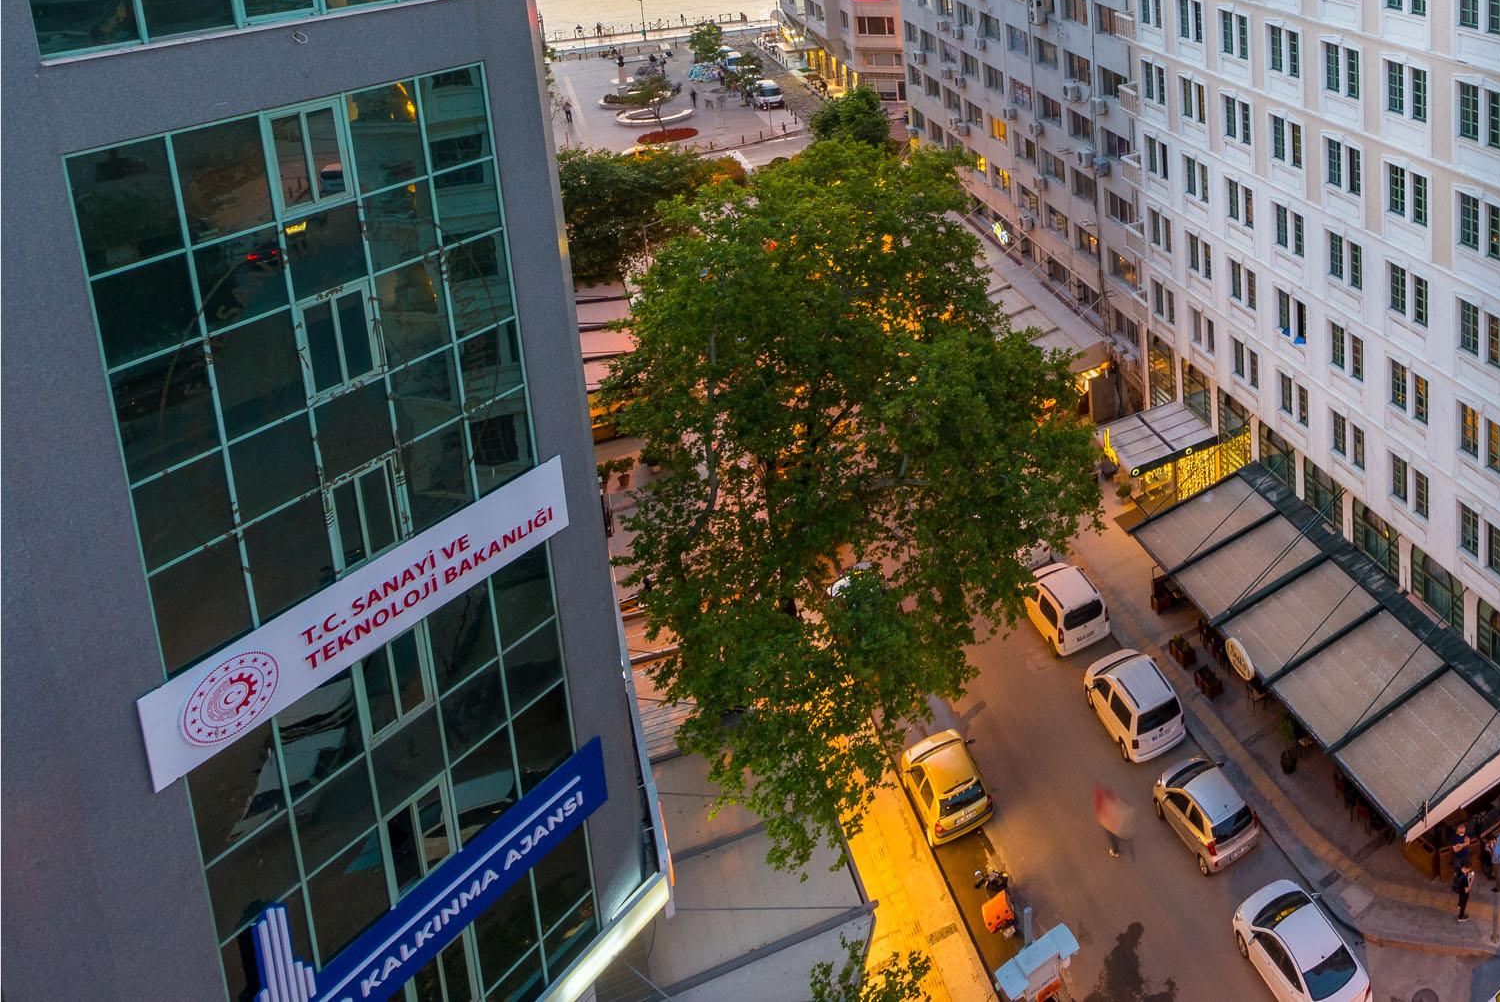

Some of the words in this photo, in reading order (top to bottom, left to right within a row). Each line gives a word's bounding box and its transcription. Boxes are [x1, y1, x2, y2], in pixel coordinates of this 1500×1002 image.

[301, 612, 347, 646] T.C.
[351, 549, 437, 616] SANAYİ
[441, 534, 471, 560] VE
[304, 574, 438, 670] TEKNOLOJİ
[444, 506, 555, 586] BAKANLIĞI
[360, 868, 499, 999] KALKINMA
[503, 790, 584, 871] AJANSI
